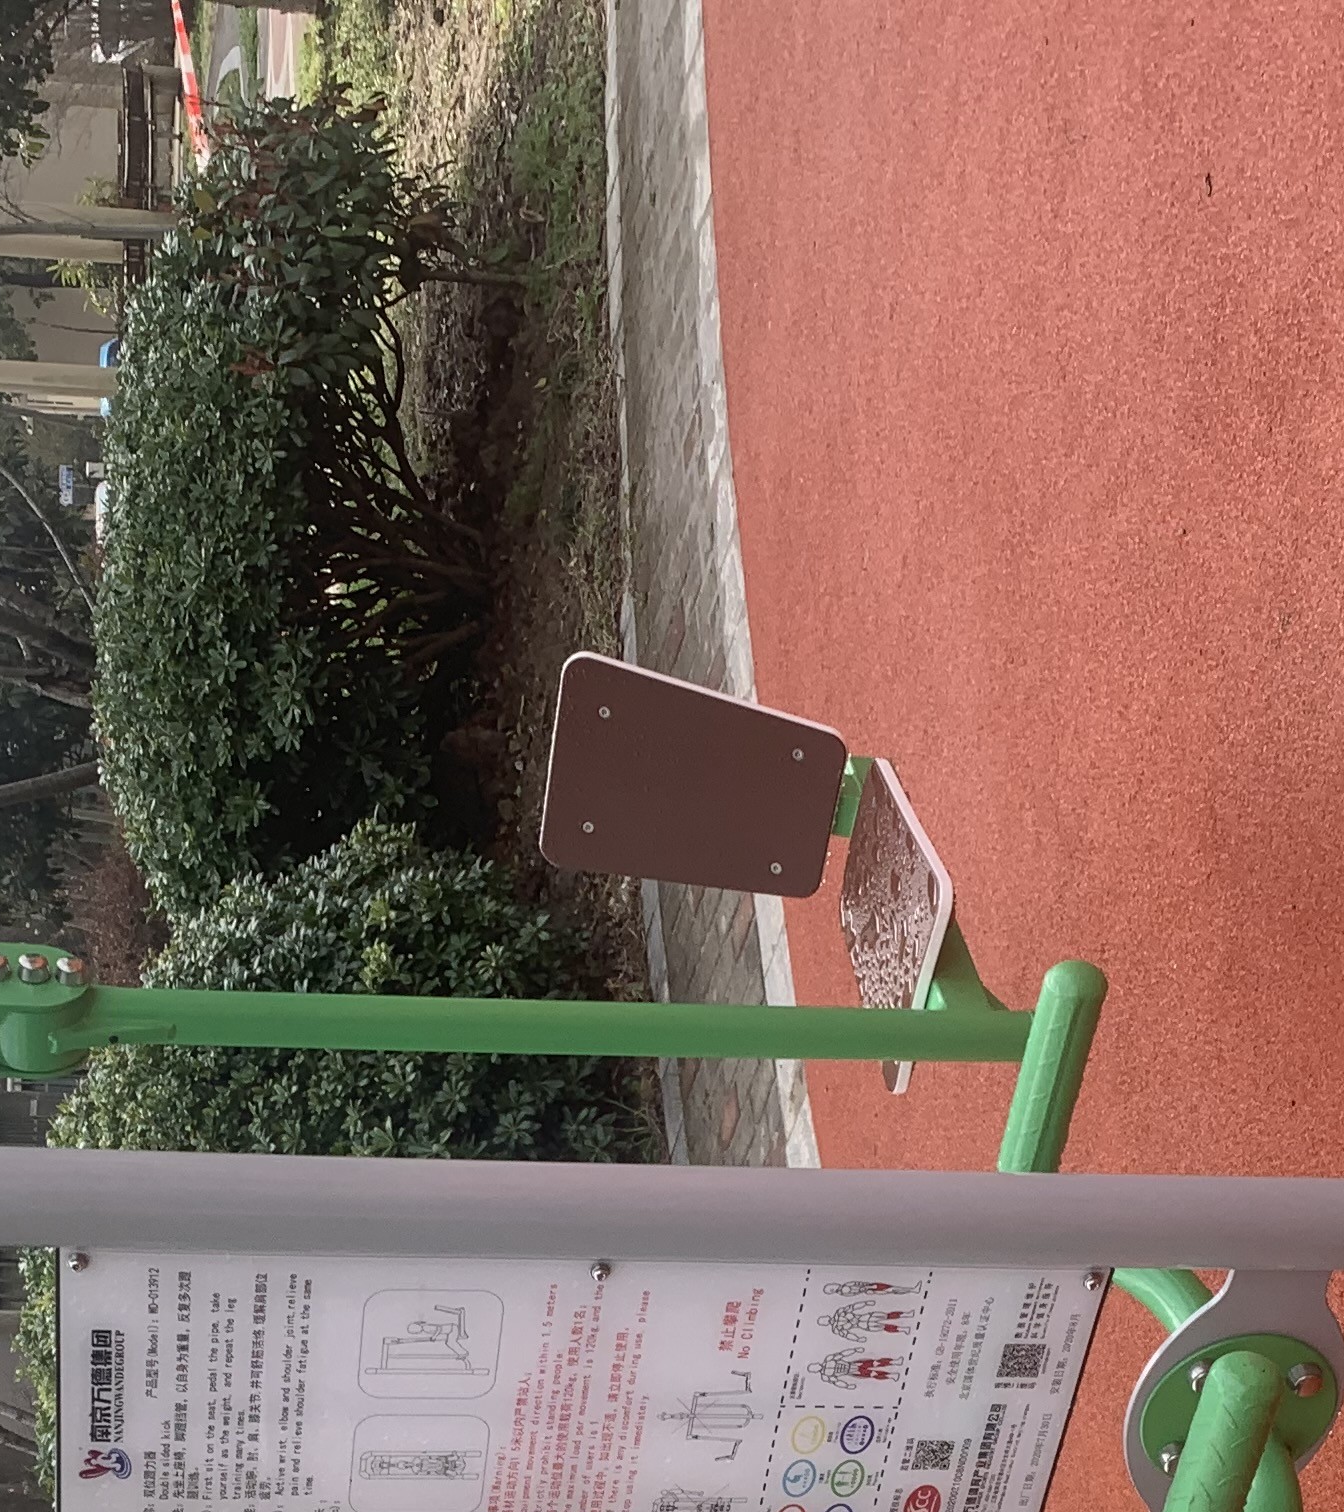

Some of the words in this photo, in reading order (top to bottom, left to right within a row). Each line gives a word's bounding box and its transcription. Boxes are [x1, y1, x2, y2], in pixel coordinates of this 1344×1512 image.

[303, 1279, 312, 1299] same
[546, 1283, 557, 1316] meters
[593, 1283, 604, 1300] the
[209, 1292, 220, 1313] take
[224, 1297, 237, 1312] leg
[299, 1304, 310, 1319] the
[591, 1305, 601, 1322] and
[636, 1290, 650, 1322] please
[740, 1288, 764, 1339] Climbing
[223, 1318, 234, 1333] the
[299, 1324, 309, 1334] at
[717, 1301, 741, 1351] 禁止攀爬
[207, 1347, 218, 1362] the
[224, 1338, 234, 1367] repeat
[280, 1344, 292, 1383] shoulder
[295, 1339, 309, 1373] fatigue
[538, 1342, 549, 1374] within
[583, 1358, 593, 1368] is
[736, 1345, 750, 1358] No
[206, 1368, 217, 1392] pedal
[222, 1372, 232, 1387] and
[626, 1353, 641, 1385] during
[89, 1329, 112, 1442] 南京万德集团
[113, 1329, 124, 1442] NANJINGWANDEGROUP
[280, 1387, 290, 1402] and
[293, 1378, 305, 1416] shoulder
[578, 1374, 591, 1416] movement
[529, 1378, 544, 1425] direction
[545, 1389, 560, 1430] standing
[278, 1406, 289, 1430] elbow
[617, 1390, 634, 1440] discomfort
[160, 1419, 170, 1439] kick
[206, 1424, 215, 1439] the
[218, 1429, 229, 1444] the
[291, 1420, 302, 1454] relieve
[575, 1420, 584, 1435] per
[587, 1429, 598, 1439] is
[159, 1443, 170, 1467] sided
[206, 1443, 214, 1454] on
[221, 1448, 228, 1458] as
[235, 1439, 245, 1459] many
[525, 1430, 538, 1470] movement
[540, 1435, 552, 1475] prohibit
[568, 1439, 581, 1459] load
[585, 1444, 595, 1470] users
[616, 1445, 626, 1460] any
[630, 1455, 638, 1464] it
[203, 1457, 214, 1472] sit
[290, 1458, 300, 1473] and
[614, 1464, 622, 1473] is
[159, 1471, 169, 1500] Double
[201, 1476, 213, 1500] First
[217, 1463, 228, 1500] yourself
[231, 1462, 244, 1499] training
[274, 1467, 285, 1496] Active
[288, 1476, 299, 1496] pain
[566, 1464, 577, 1499] maximum
[581, 1474, 591, 1484] of
[607, 1479, 619, 1503] there
[626, 1469, 637, 1494] using
